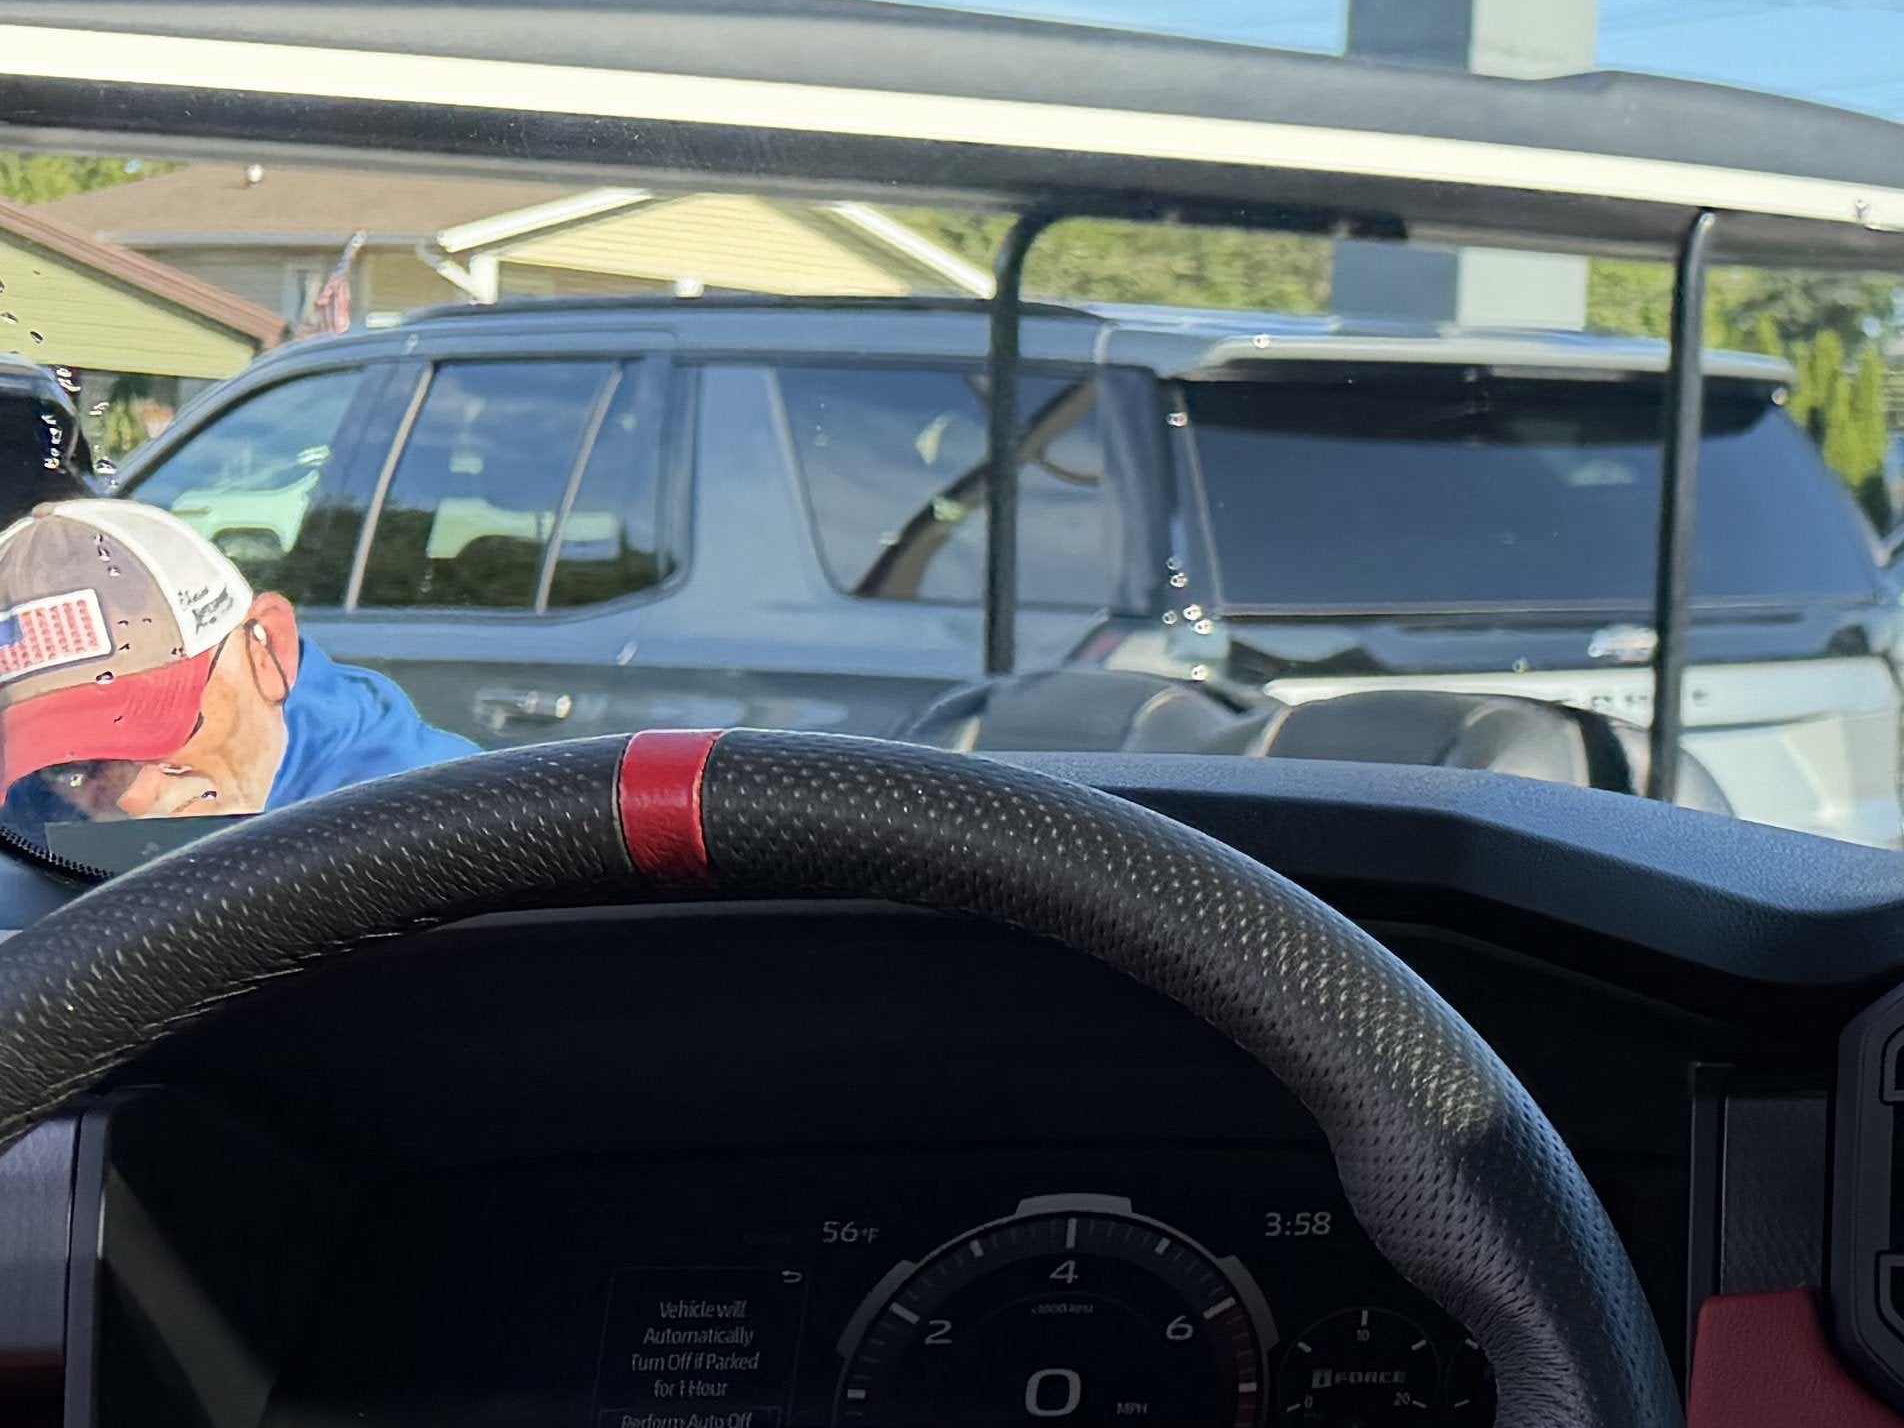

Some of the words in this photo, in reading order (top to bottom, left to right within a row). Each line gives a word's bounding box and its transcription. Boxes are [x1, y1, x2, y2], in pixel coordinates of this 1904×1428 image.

[1264, 1212, 1332, 1237] 3:58
[1048, 1259, 1080, 1285] 4
[659, 1299, 715, 1319] Vehicle
[716, 1299, 748, 1319] will
[642, 1326, 755, 1347] Automatically
[923, 1320, 954, 1345] 2
[1165, 1314, 1195, 1341] 6
[631, 1353, 665, 1372] Turn
[667, 1352, 692, 1371] Off
[693, 1352, 706, 1371] if
[706, 1352, 760, 1371] Parked
[653, 1379, 677, 1399] for
[687, 1380, 730, 1398] Hour
[1025, 1368, 1083, 1417] 0
[1116, 1401, 1148, 1415] MPH
